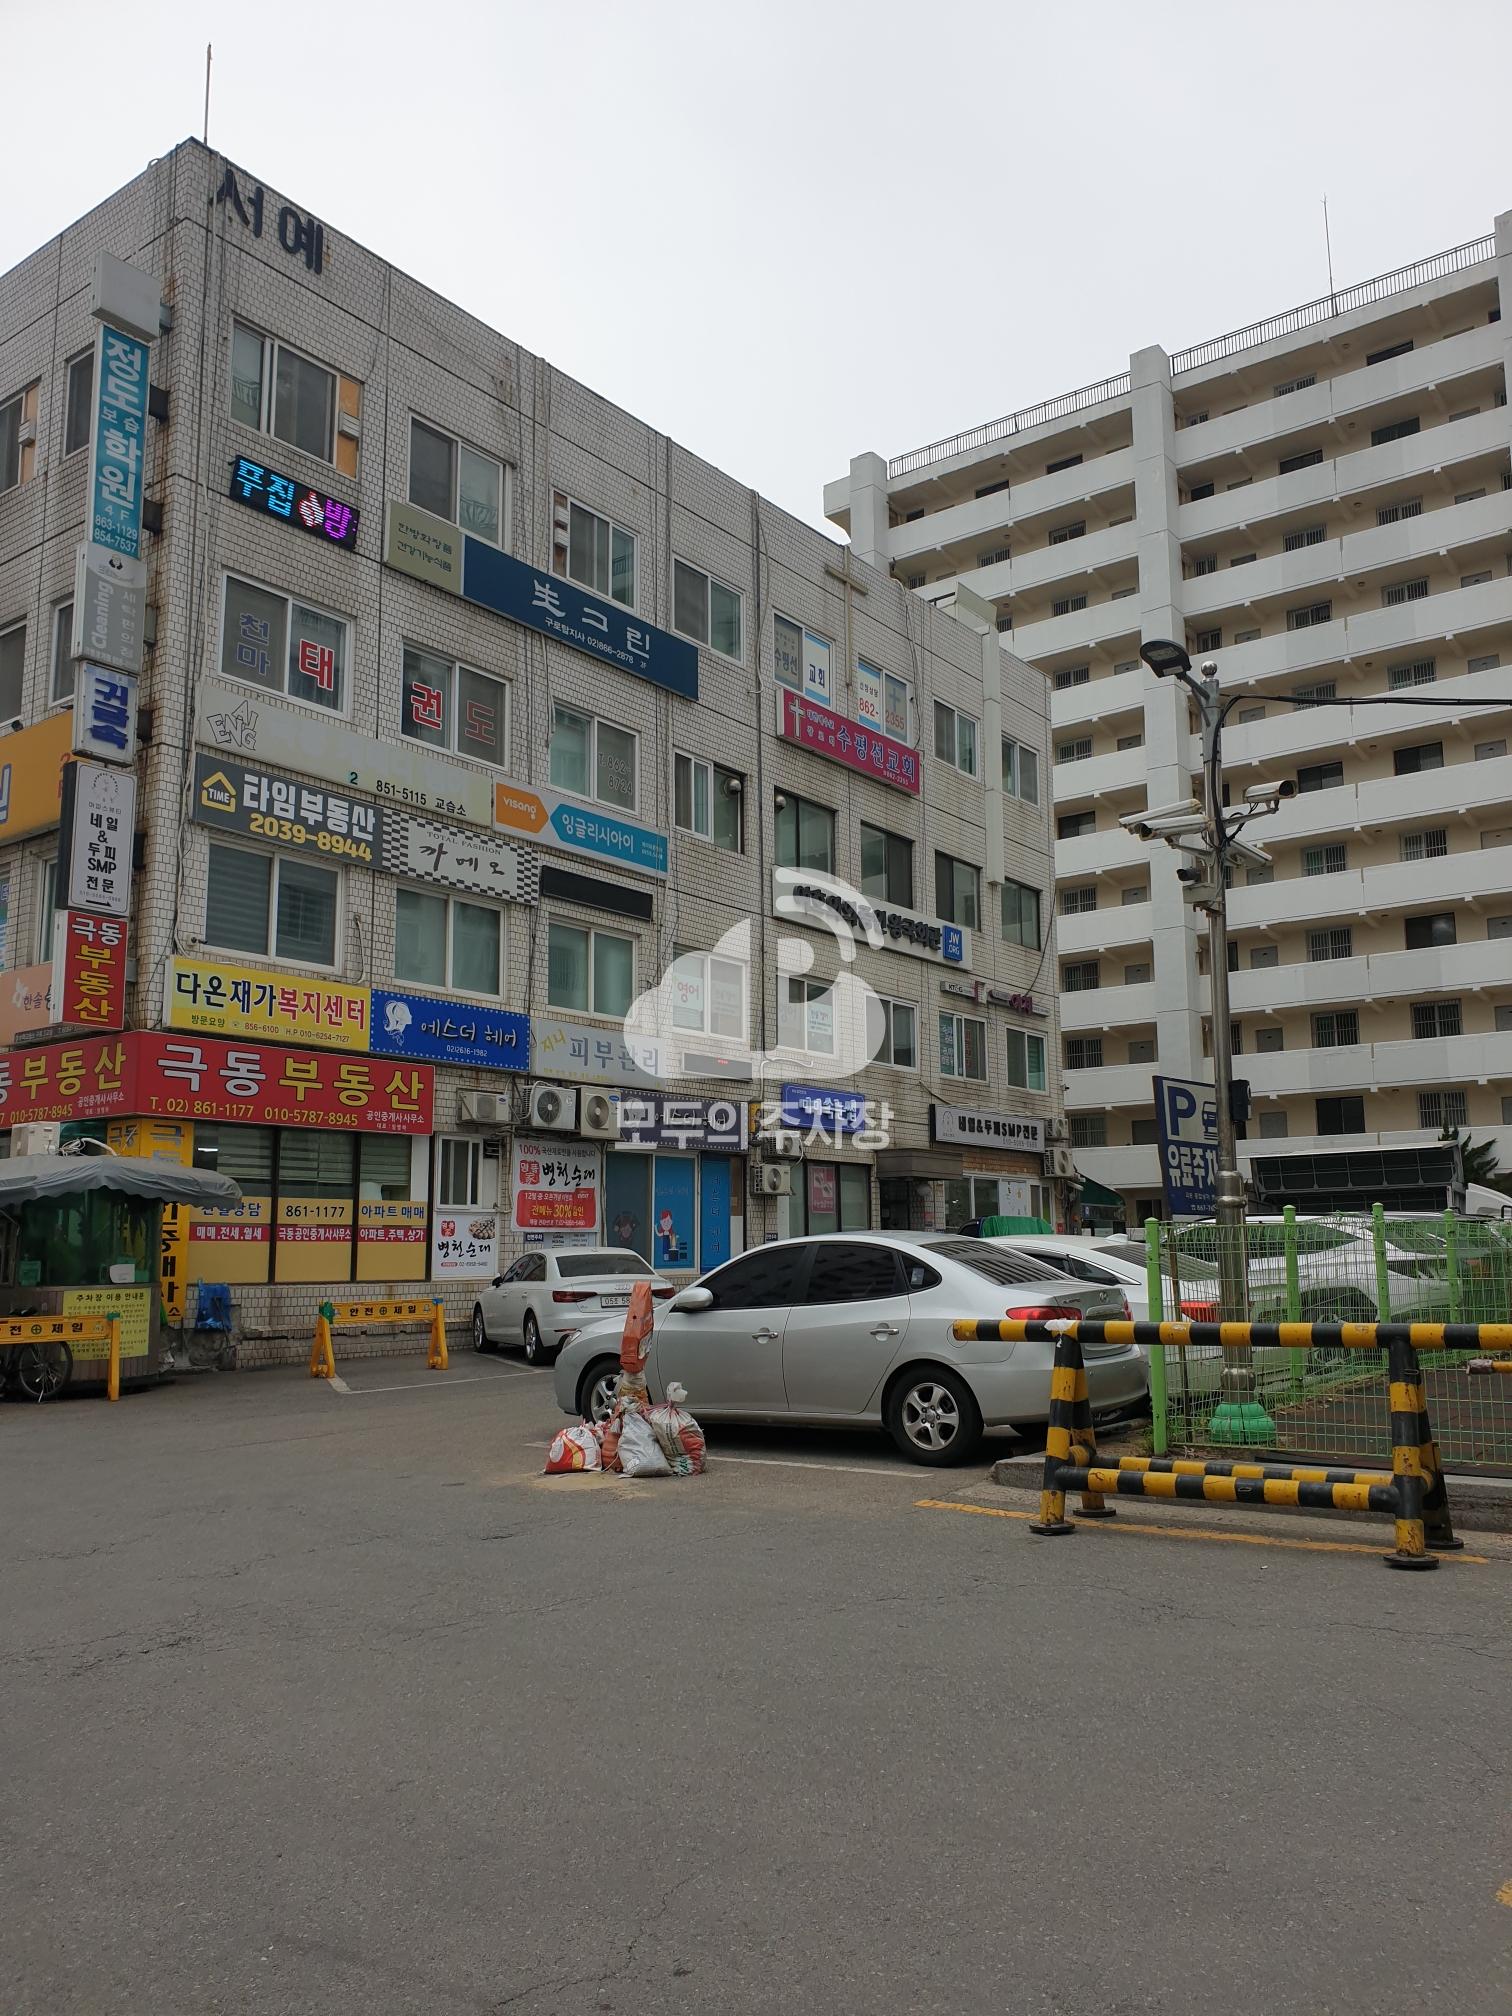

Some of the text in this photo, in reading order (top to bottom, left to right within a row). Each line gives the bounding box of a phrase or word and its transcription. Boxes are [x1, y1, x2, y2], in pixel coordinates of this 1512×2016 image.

[210, 168, 324, 275] 서예
[101, 336, 143, 418] 정도
[98, 428, 142, 509] 학원
[95, 514, 138, 540] 863-1129
[94, 527, 137, 553] 854-7537
[91, 580, 114, 649] Cleaning
[236, 612, 270, 677] 천마
[808, 664, 826, 688] 교회
[299, 638, 496, 746] 태 권 도
[858, 697, 879, 719] 862-
[837, 725, 915, 784] 수평선교회
[207, 787, 230, 804] TIME
[242, 773, 376, 842] 타임부동산
[376, 779, 427, 806] 851-5115
[434, 797, 467, 817] 교습소
[503, 795, 538, 820] visang
[89, 812, 118, 832] 네일
[561, 813, 634, 854] 잉글리시아이
[97, 830, 109, 844] &
[249, 813, 373, 862] 2039-8944
[426, 830, 460, 847] TOTAL
[461, 841, 502, 856] FASHION
[87, 841, 117, 861] 두피
[418, 842, 506, 876] 까메오
[87, 857, 117, 875] SMP
[85, 875, 114, 894] 전문
[72, 917, 123, 946] 극동
[949, 931, 960, 945] JW
[73, 944, 117, 1023] 부동산
[677, 981, 700, 1003] 영어
[175, 971, 366, 1031] 다온재가복지센터
[191, 1013, 225, 1029] 방문요양
[420, 1018, 518, 1048] 에스더 헤어
[568, 1035, 659, 1077] 피부관리
[155, 1042, 425, 1112] 극동부동산
[10, 1103, 73, 1124] 010-5787-8945
[166, 1096, 190, 1115] 02)
[193, 1100, 255, 1120] 861-1177
[264, 1106, 359, 1127] 010-5787-8945
[1167, 1085, 1197, 1137] P
[519, 1143, 542, 1156] 100%
[541, 1160, 596, 1188] 병천순대
[285, 1204, 346, 1219] 861-1177
[361, 1205, 425, 1220] 아파트 매매
[553, 1203, 573, 1219] 30%
[278, 1227, 352, 1242] 극동공인중개사사무소
[437, 1239, 491, 1259] 병천순대
[75, 1291, 104, 1303] 주차장
[106, 1291, 122, 1302] 이용
[349, 1304, 418, 1317] 안전 제일
[51, 1322, 84, 1335] 제일
